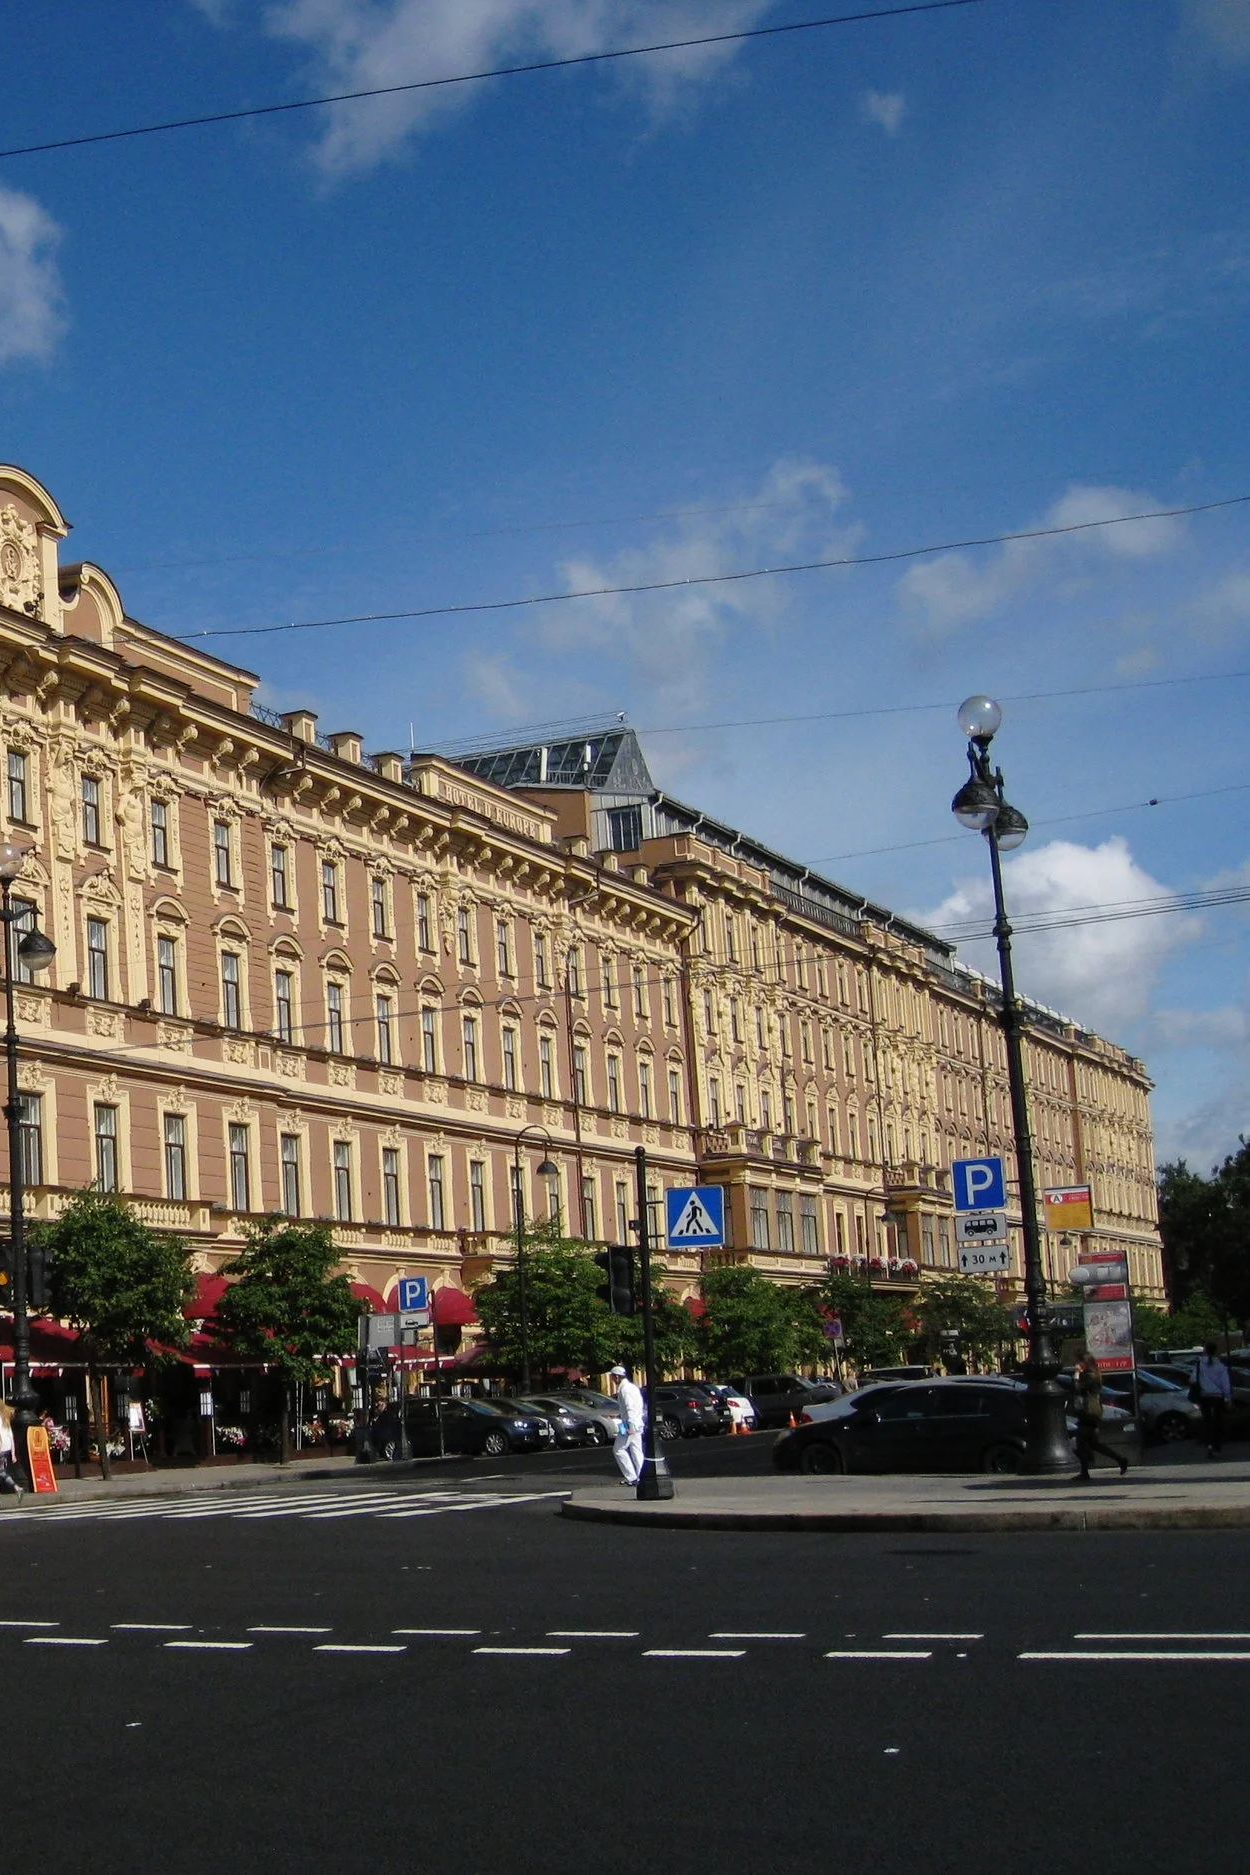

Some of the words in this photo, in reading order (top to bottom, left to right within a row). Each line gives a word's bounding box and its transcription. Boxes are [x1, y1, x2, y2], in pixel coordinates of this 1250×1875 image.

[965, 1164, 994, 1206] P
[972, 1254, 985, 1265] 30
[405, 1281, 421, 1308] P
